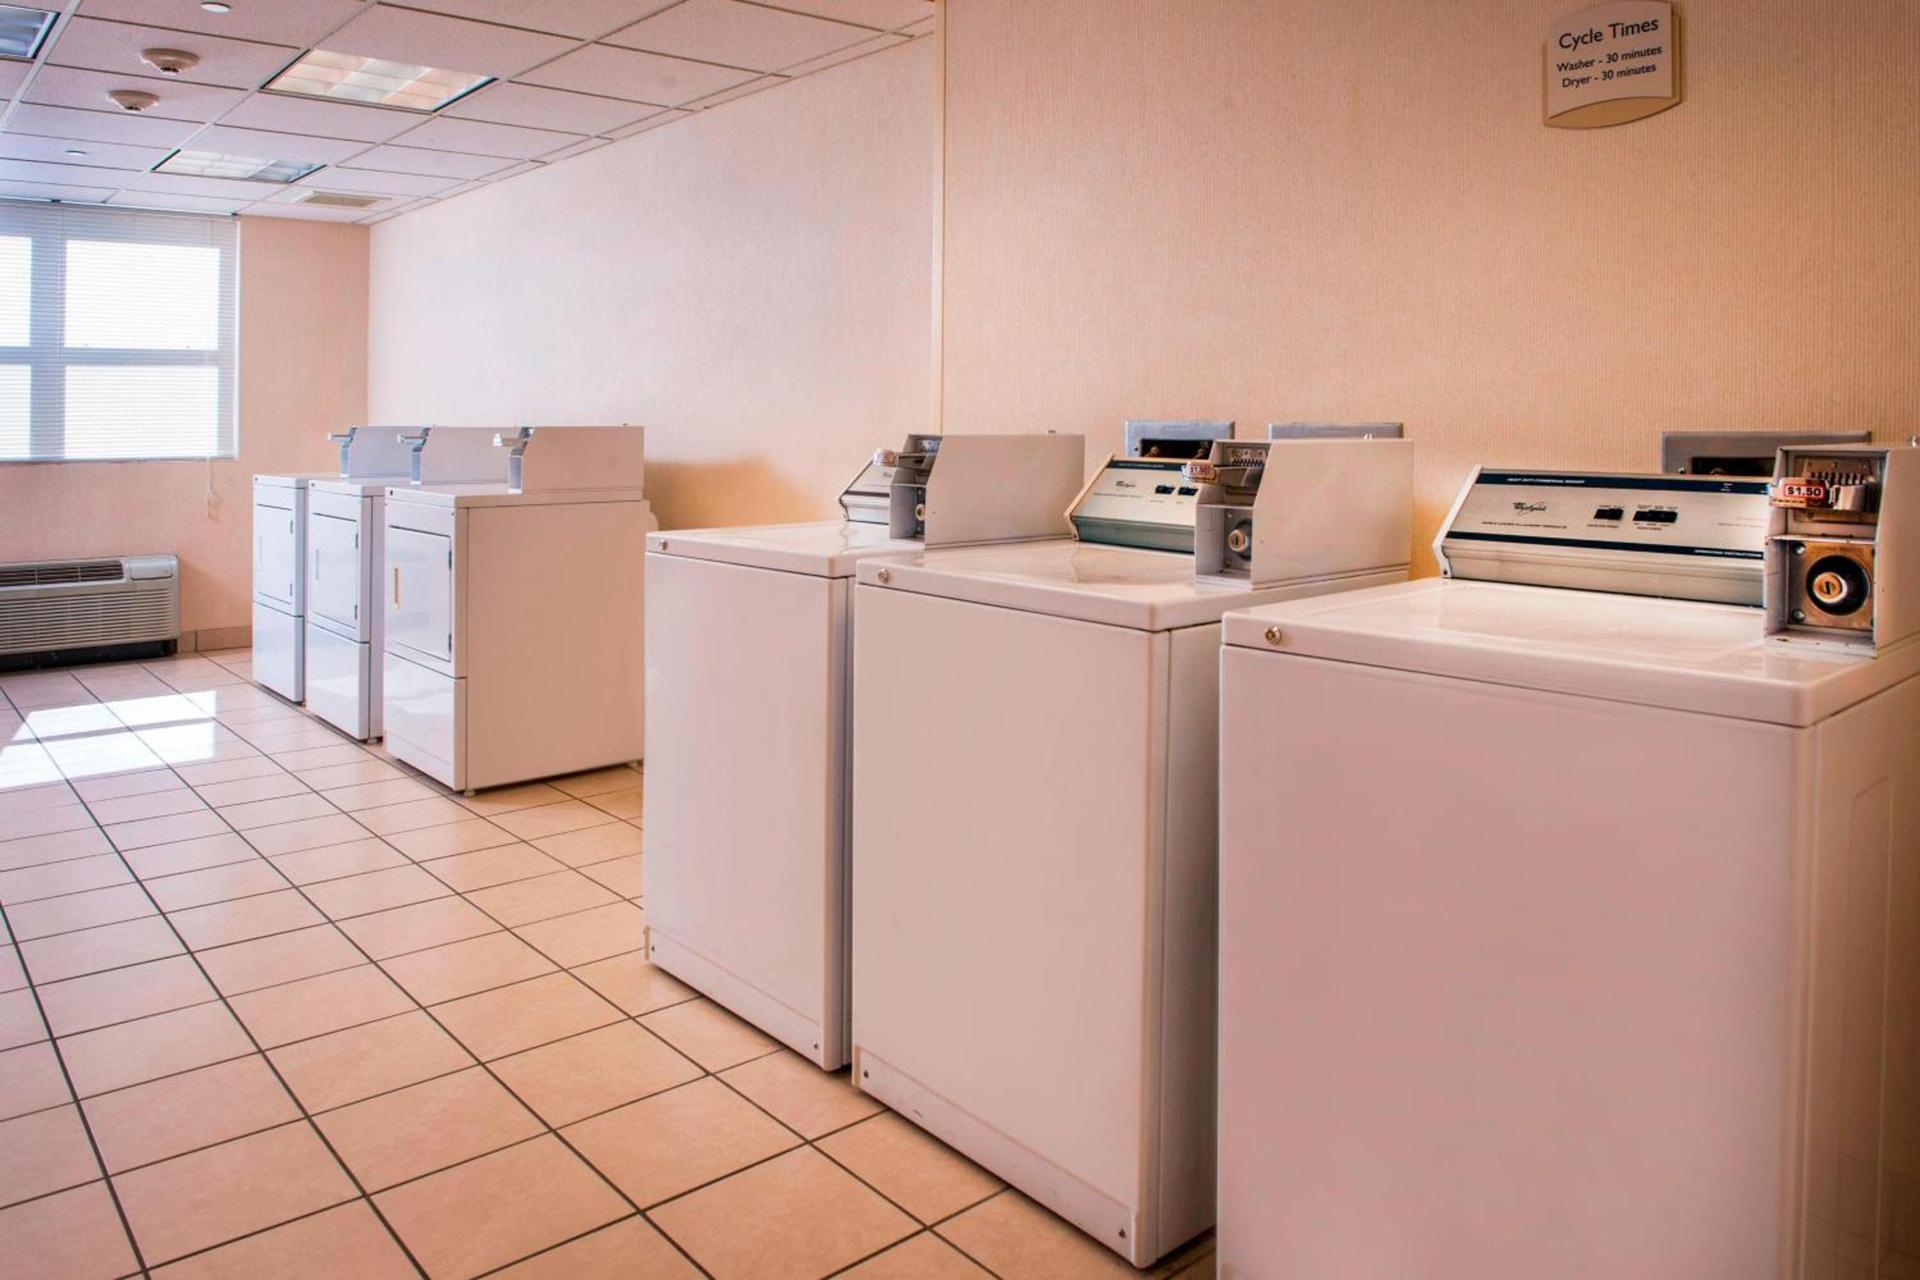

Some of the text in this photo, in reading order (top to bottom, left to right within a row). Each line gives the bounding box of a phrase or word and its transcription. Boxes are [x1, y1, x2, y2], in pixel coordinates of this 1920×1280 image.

[1559, 19, 1659, 51] Cycle Times
[1557, 58, 1596, 72] Washer
[1606, 52, 1619, 64] 30
[1621, 46, 1662, 60] minutes
[1562, 76, 1591, 88] Dryer
[1602, 70, 1614, 81] 30
[1617, 64, 1657, 78] minutes
[1787, 486, 1821, 496] $1.50
